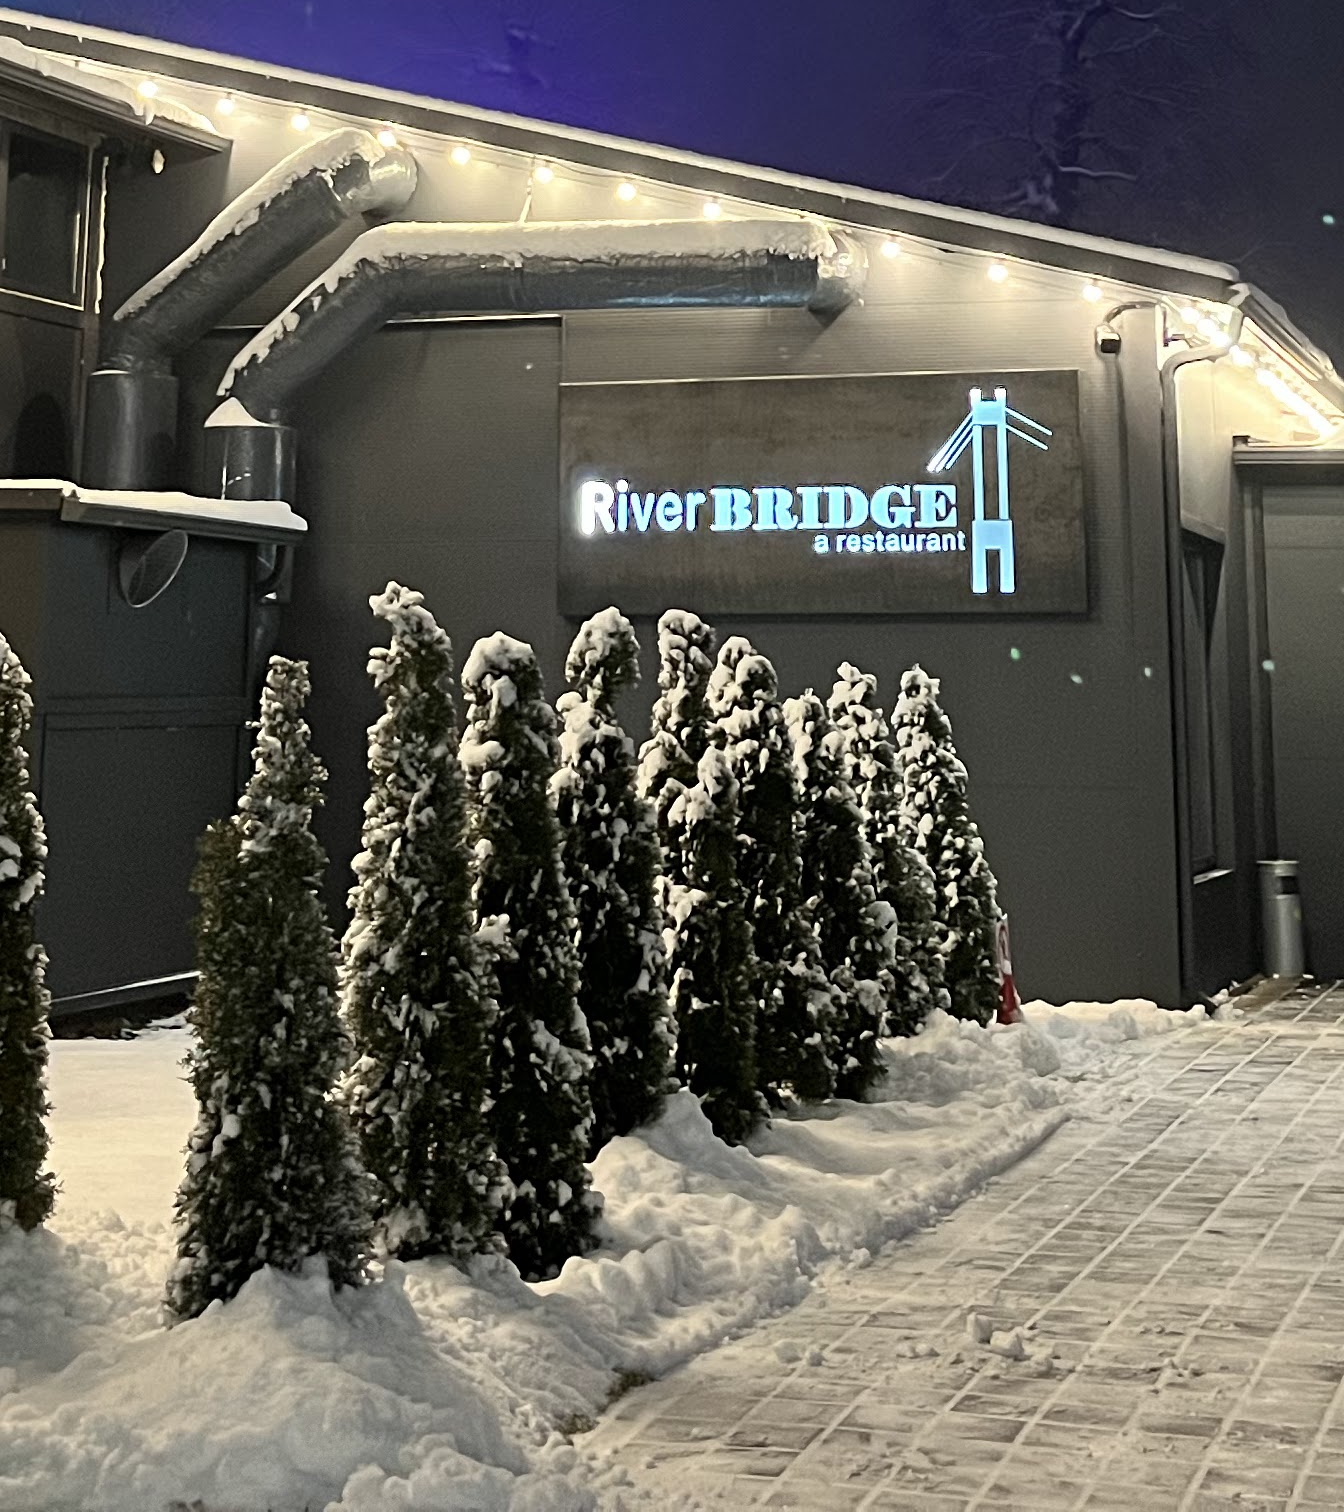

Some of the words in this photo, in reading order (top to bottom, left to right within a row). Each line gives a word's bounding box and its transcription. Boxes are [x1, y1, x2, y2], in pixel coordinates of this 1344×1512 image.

[579, 479, 706, 535] River
[710, 484, 957, 531] BRIDGE
[813, 534, 830, 553] a
[836, 529, 967, 553] restaurant
